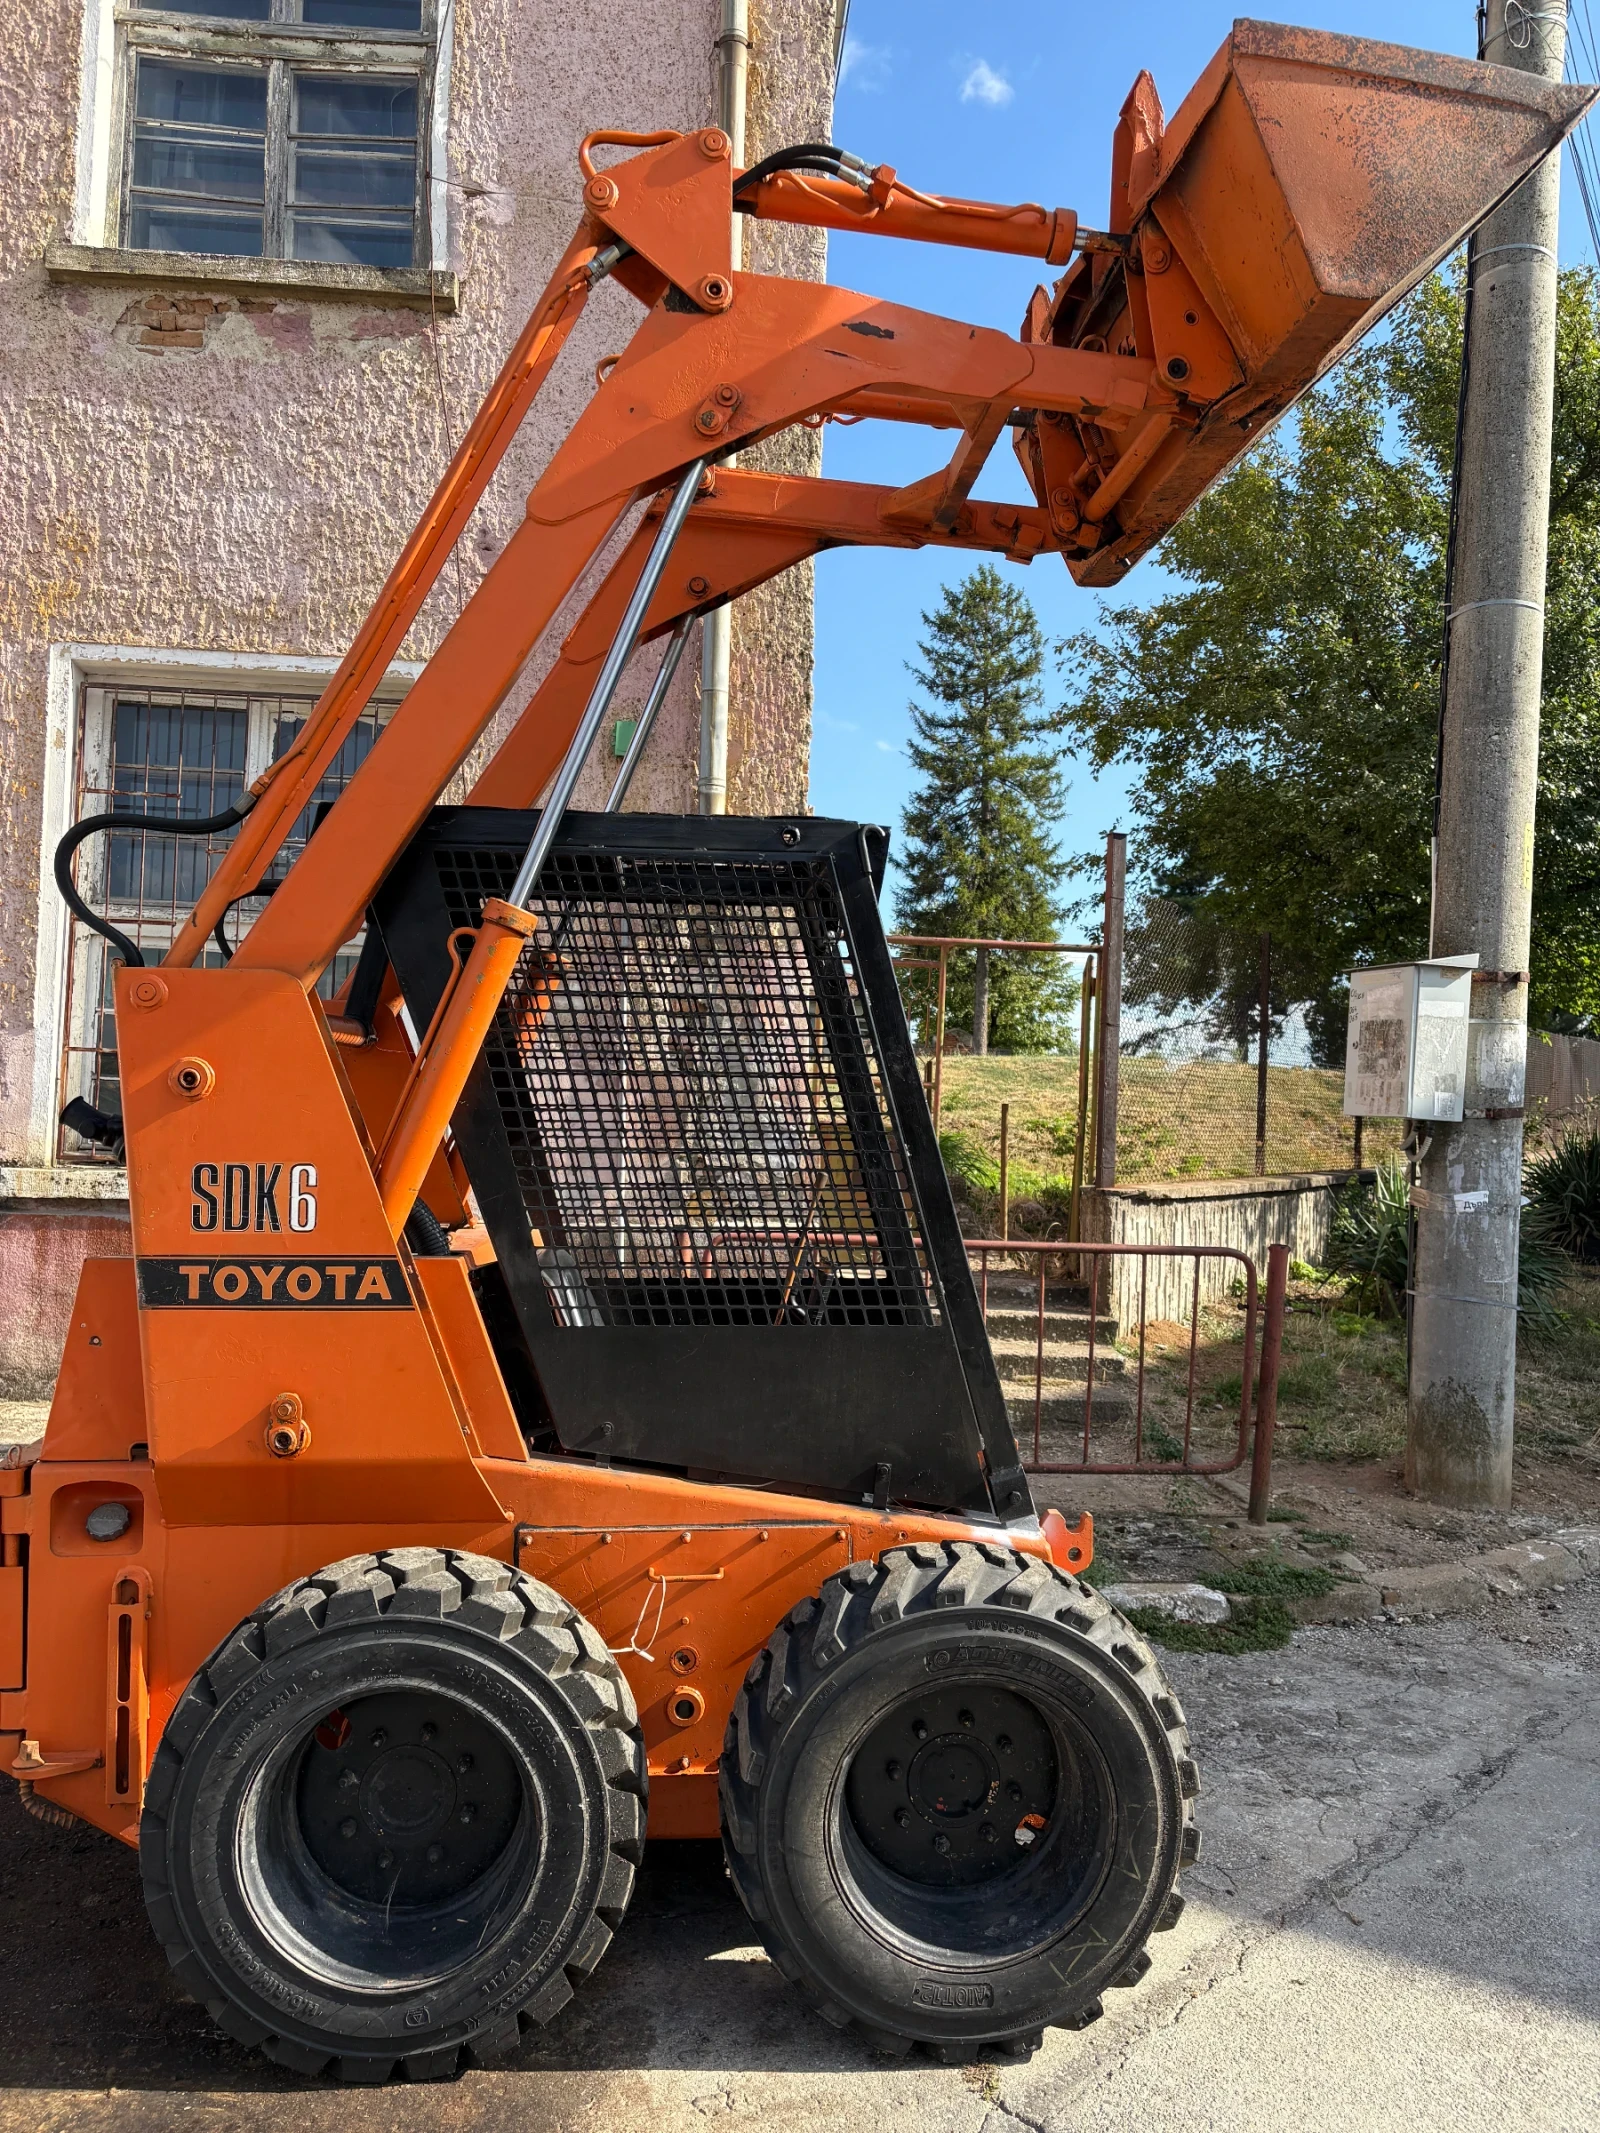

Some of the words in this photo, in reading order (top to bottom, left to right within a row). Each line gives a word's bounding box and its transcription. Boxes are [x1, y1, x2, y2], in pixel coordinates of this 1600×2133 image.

[191, 1162, 318, 1233] SDK6
[179, 1265, 392, 1301] TOYOTA
[214, 1920, 261, 1975] GUARD
[522, 1919, 552, 1957] WIDE
[481, 1959, 521, 1993] WALL
